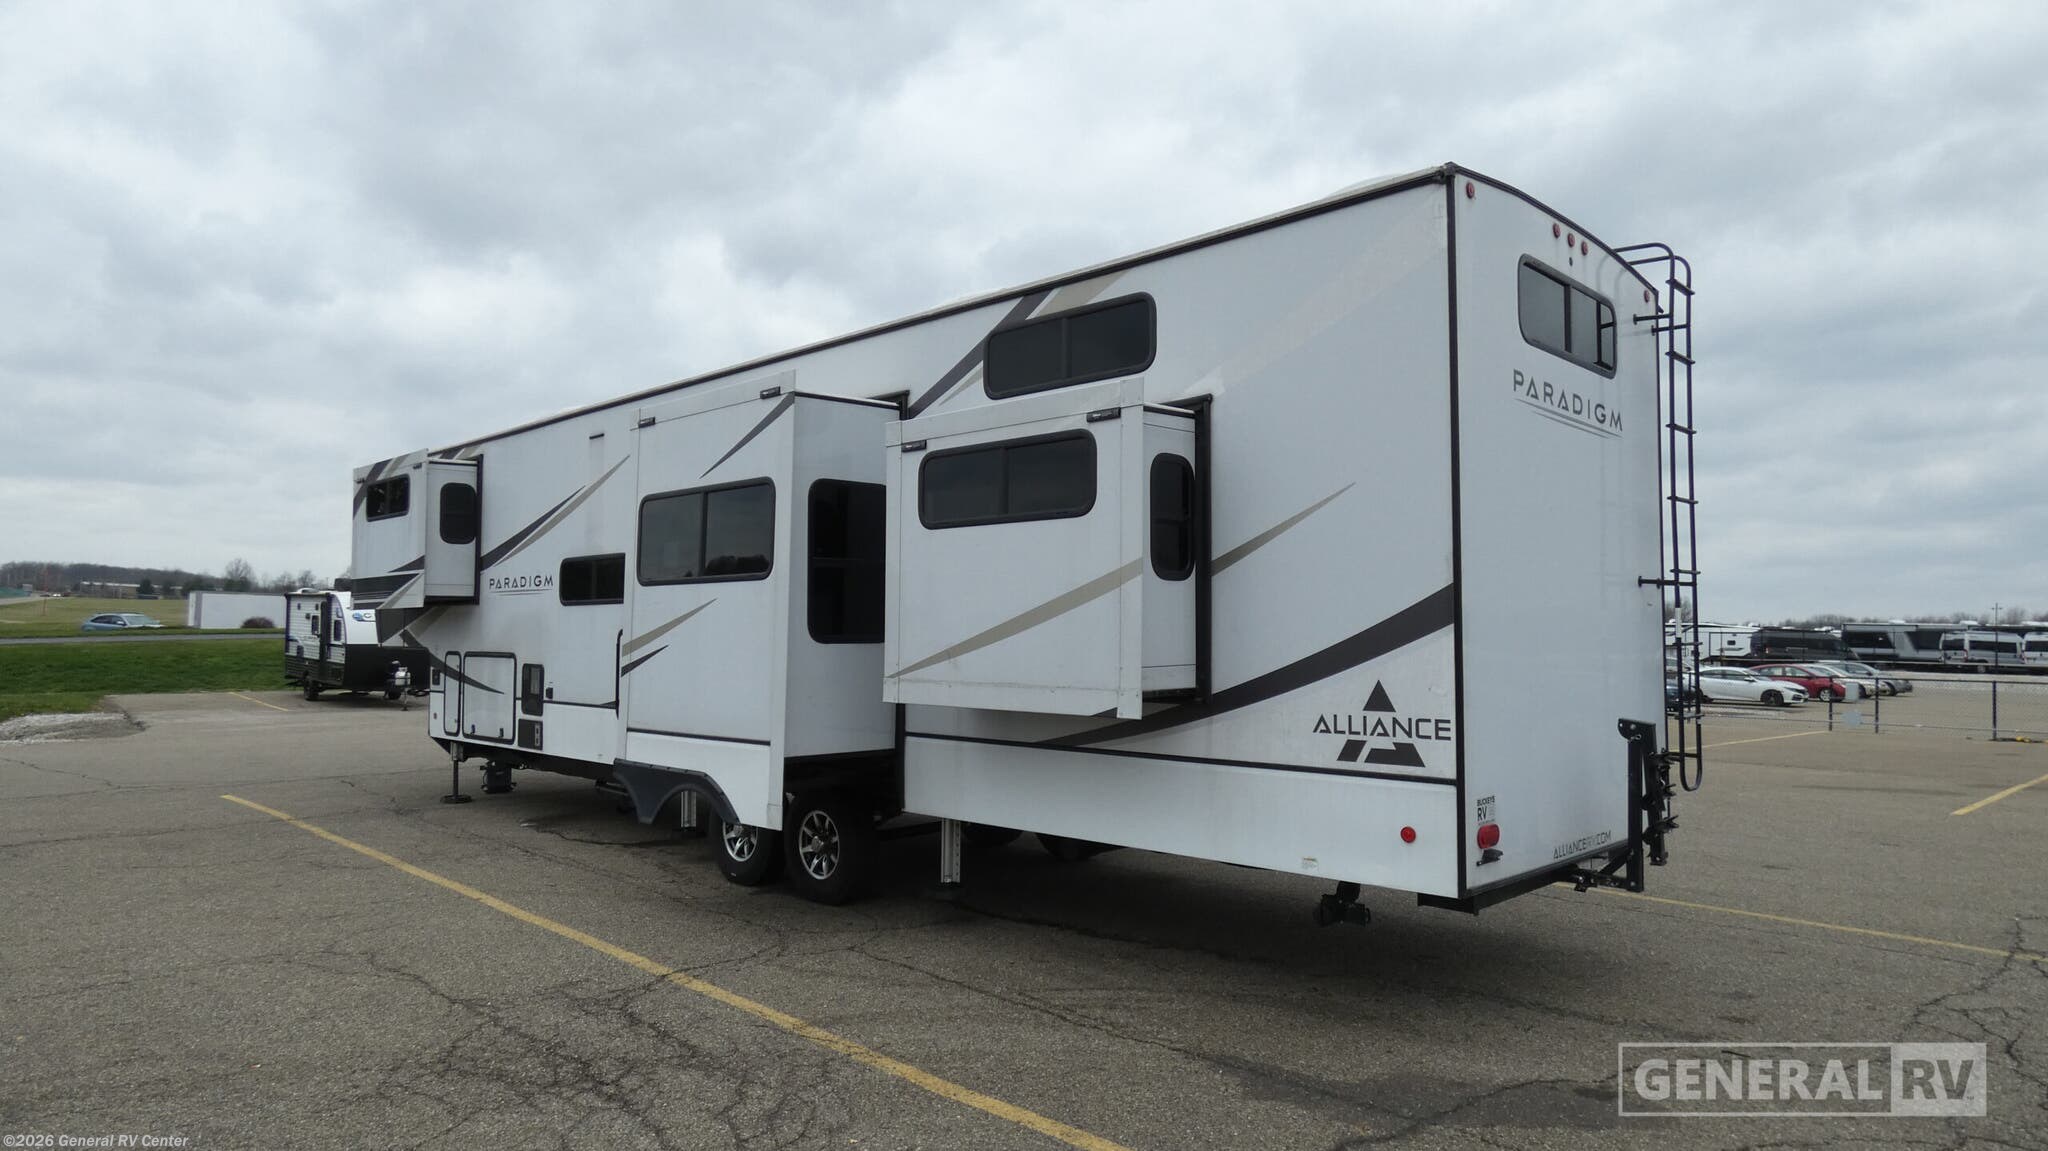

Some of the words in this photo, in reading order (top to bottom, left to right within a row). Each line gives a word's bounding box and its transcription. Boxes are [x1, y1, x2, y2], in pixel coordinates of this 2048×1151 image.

[1513, 368, 1623, 432] PARADIGM
[489, 574, 554, 590] PARADIGM
[1312, 713, 1452, 741] ALLIANCE
[1477, 806, 1488, 822] RV
